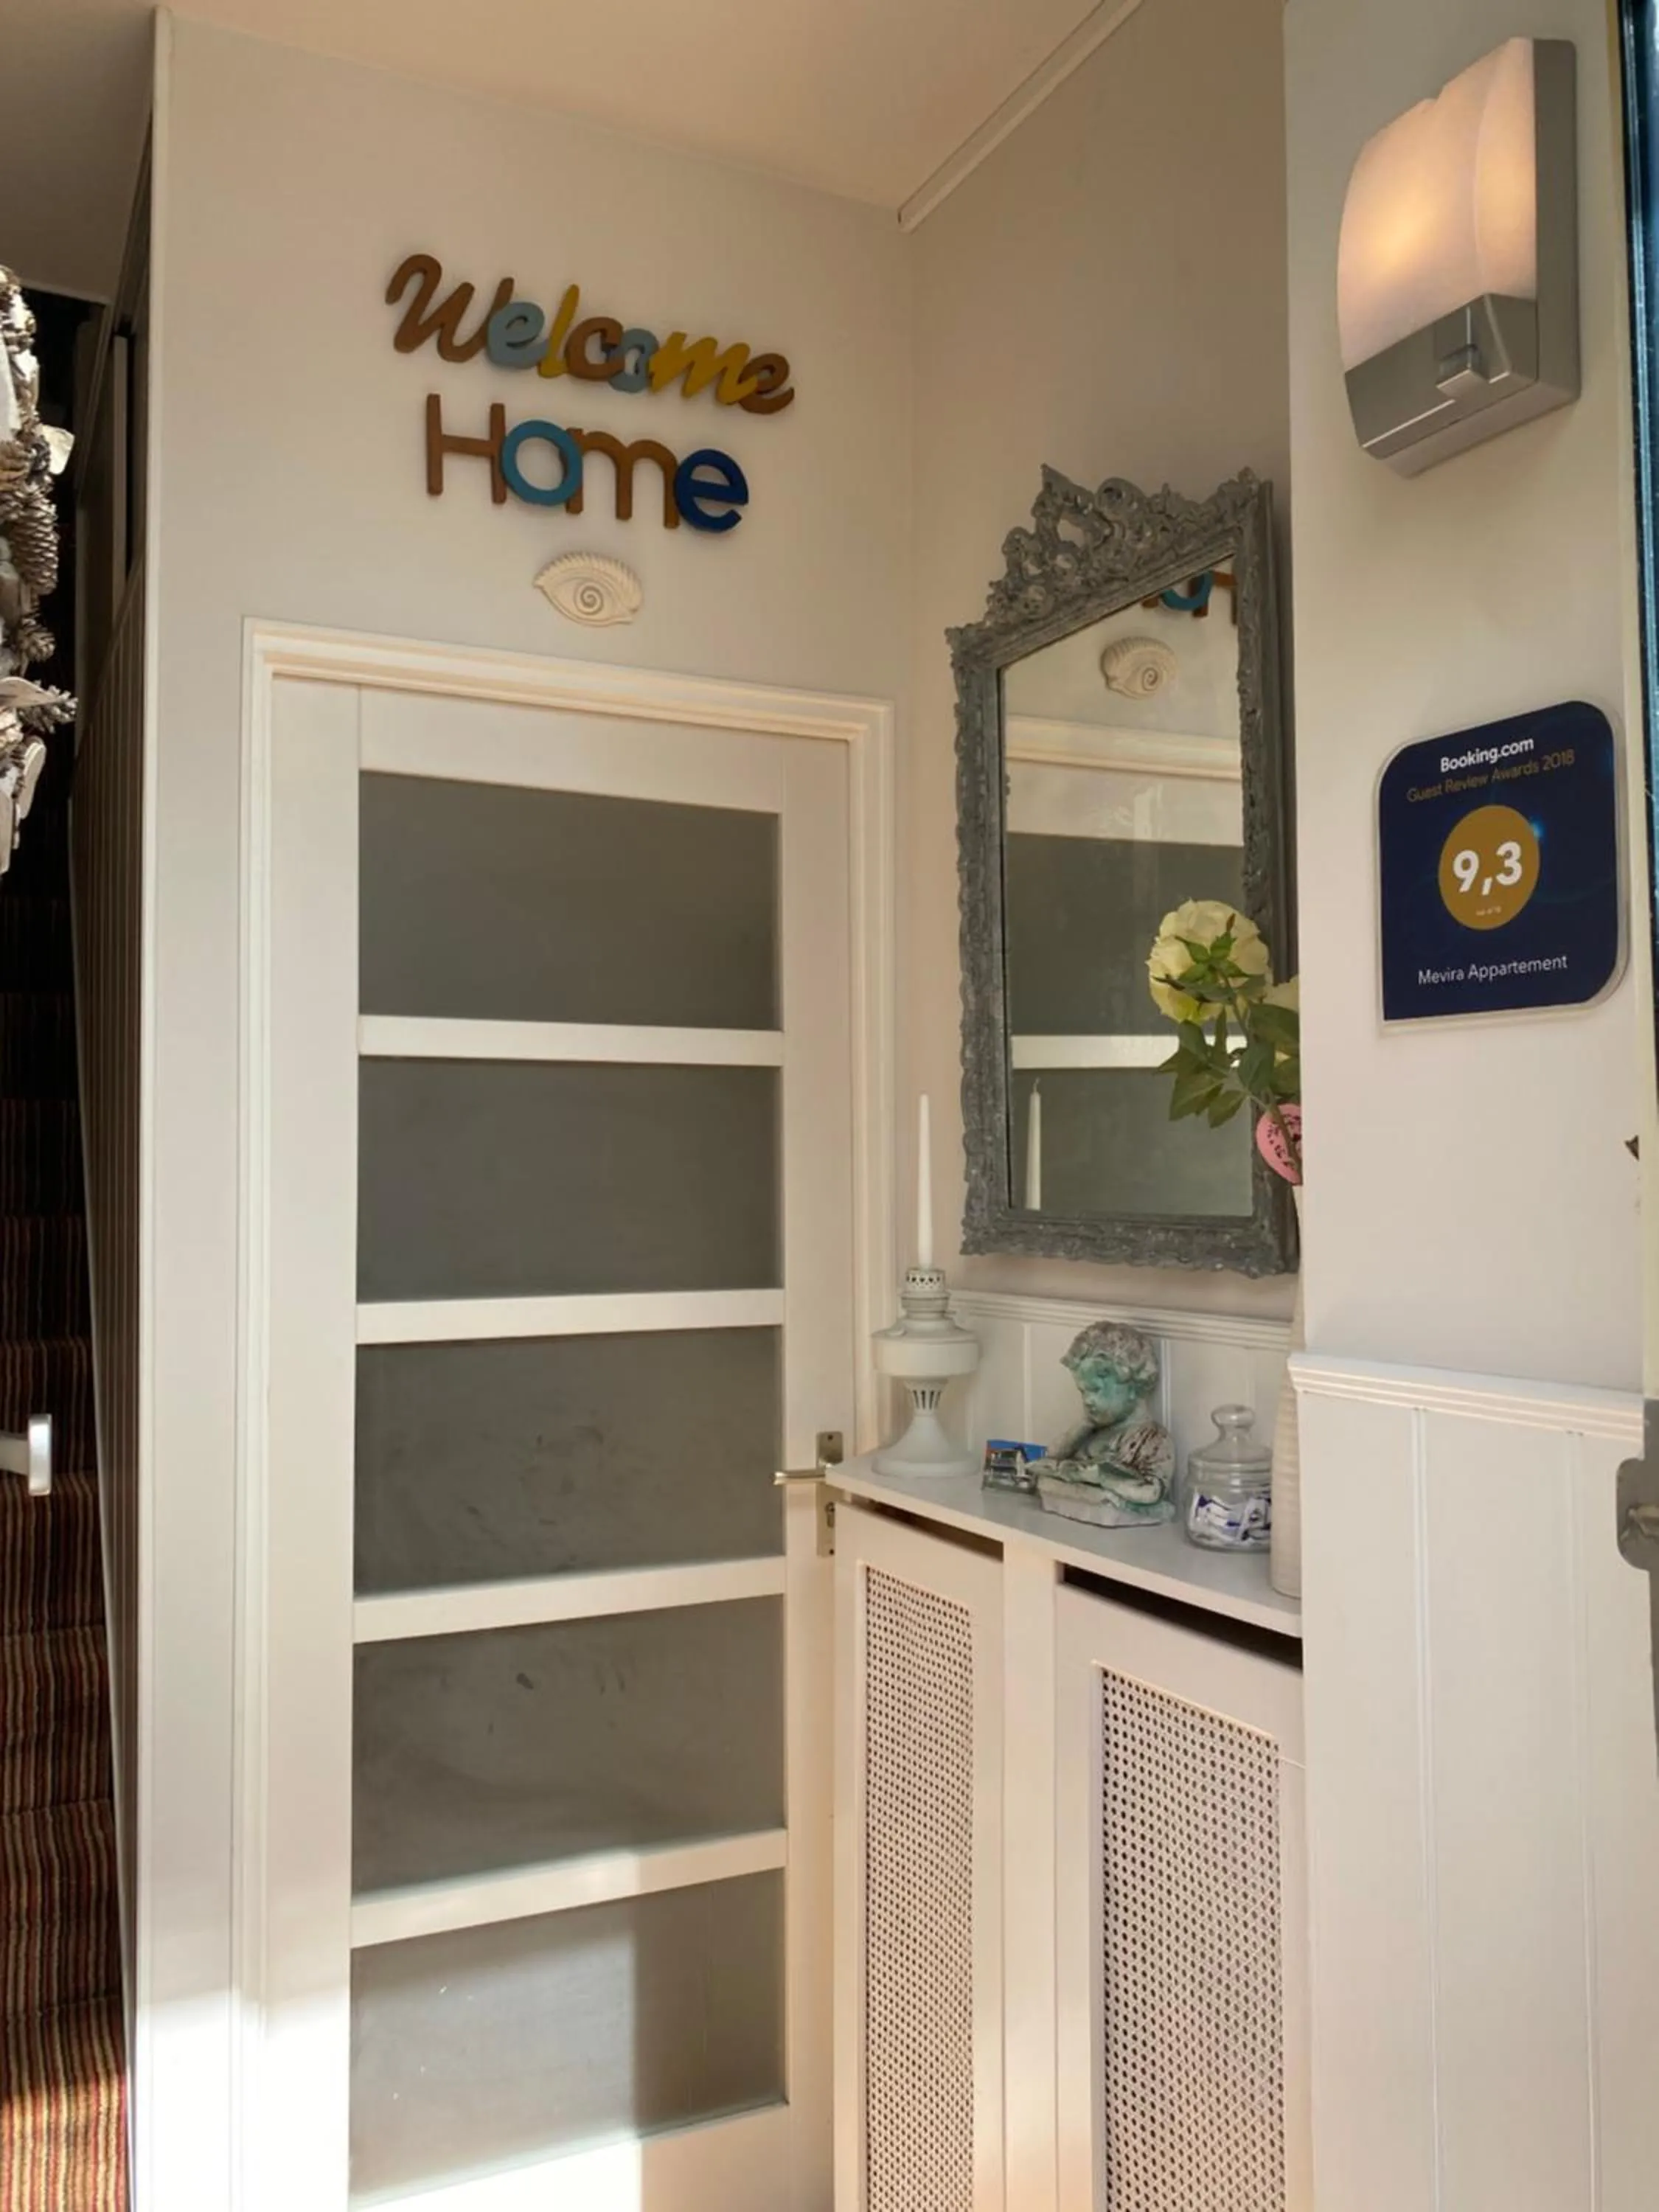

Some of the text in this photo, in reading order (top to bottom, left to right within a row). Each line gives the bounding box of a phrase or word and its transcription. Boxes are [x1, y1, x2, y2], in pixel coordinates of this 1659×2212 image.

[385, 254, 795, 414] Welcome
[425, 393, 749, 533] Home
[1406, 748, 1576, 802] Guest Review Awards 2018
[1440, 738, 1534, 773] Booking.com
[1453, 841, 1523, 896] 9,3
[1417, 956, 1568, 985] Mevira Appartement
